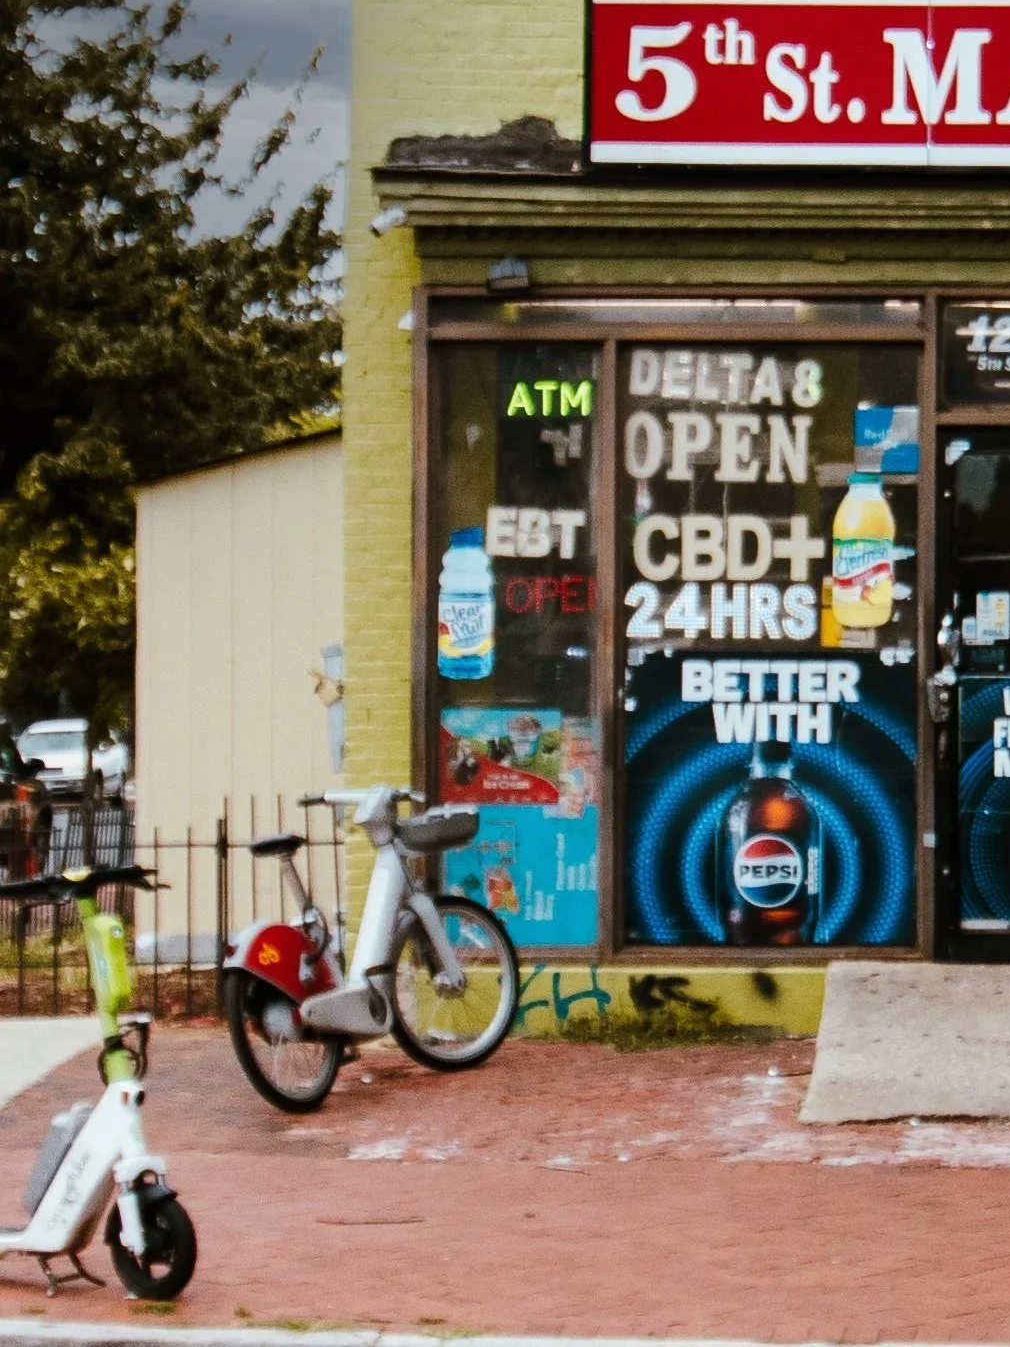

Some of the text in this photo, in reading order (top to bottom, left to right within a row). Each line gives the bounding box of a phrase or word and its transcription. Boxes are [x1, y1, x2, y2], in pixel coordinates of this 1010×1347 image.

[614, 18, 756, 123] 5th
[763, 41, 867, 124] St.
[506, 380, 594, 417] ATM
[629, 350, 824, 408] DELTA 8
[624, 410, 814, 484] OPEN
[486, 505, 587, 560] EBT
[633, 513, 826, 582] CBD+
[504, 574, 599, 614] OPE
[681, 659, 860, 703] BETTER
[712, 702, 832, 743] WITH
[739, 864, 798, 879] PEPSI
